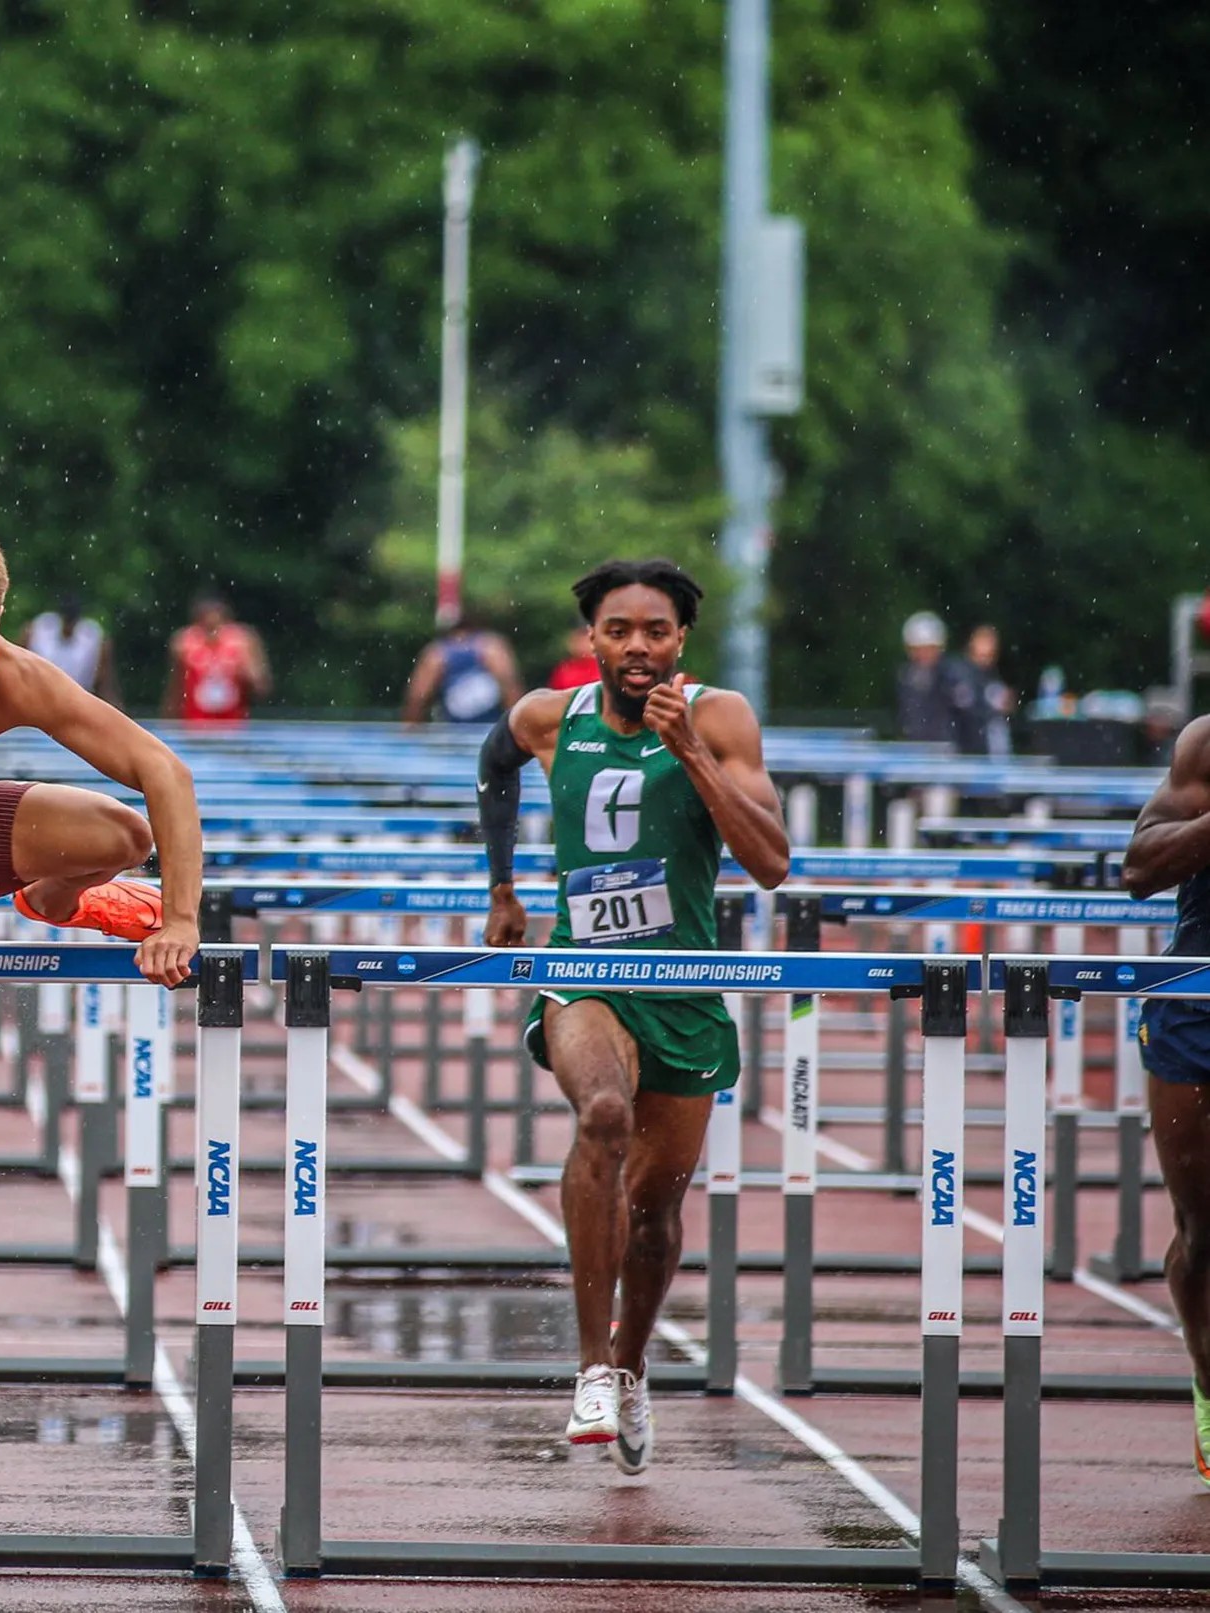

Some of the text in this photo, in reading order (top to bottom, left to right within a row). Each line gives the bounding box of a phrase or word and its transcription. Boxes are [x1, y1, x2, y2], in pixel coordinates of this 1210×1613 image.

[589, 894, 648, 932] 201
[1084, 904, 1178, 919] CHAMPIONSHI
[356, 960, 383, 970] GILL
[546, 962, 783, 981] TRACK & FIELD CHAMPIONSHIPS
[867, 968, 894, 977] GILL
[1075, 970, 1102, 980] GILL
[134, 1038, 152, 1098] NCAA
[207, 1140, 230, 1216] NCAA
[294, 1139, 317, 1215] NCAA
[932, 1149, 954, 1226] NCAA
[1013, 1149, 1036, 1226] NCAA
[202, 1301, 232, 1311] GILL
[290, 1301, 319, 1311] GILL
[927, 1311, 956, 1321] GILL
[1009, 1311, 1038, 1321] GILL
